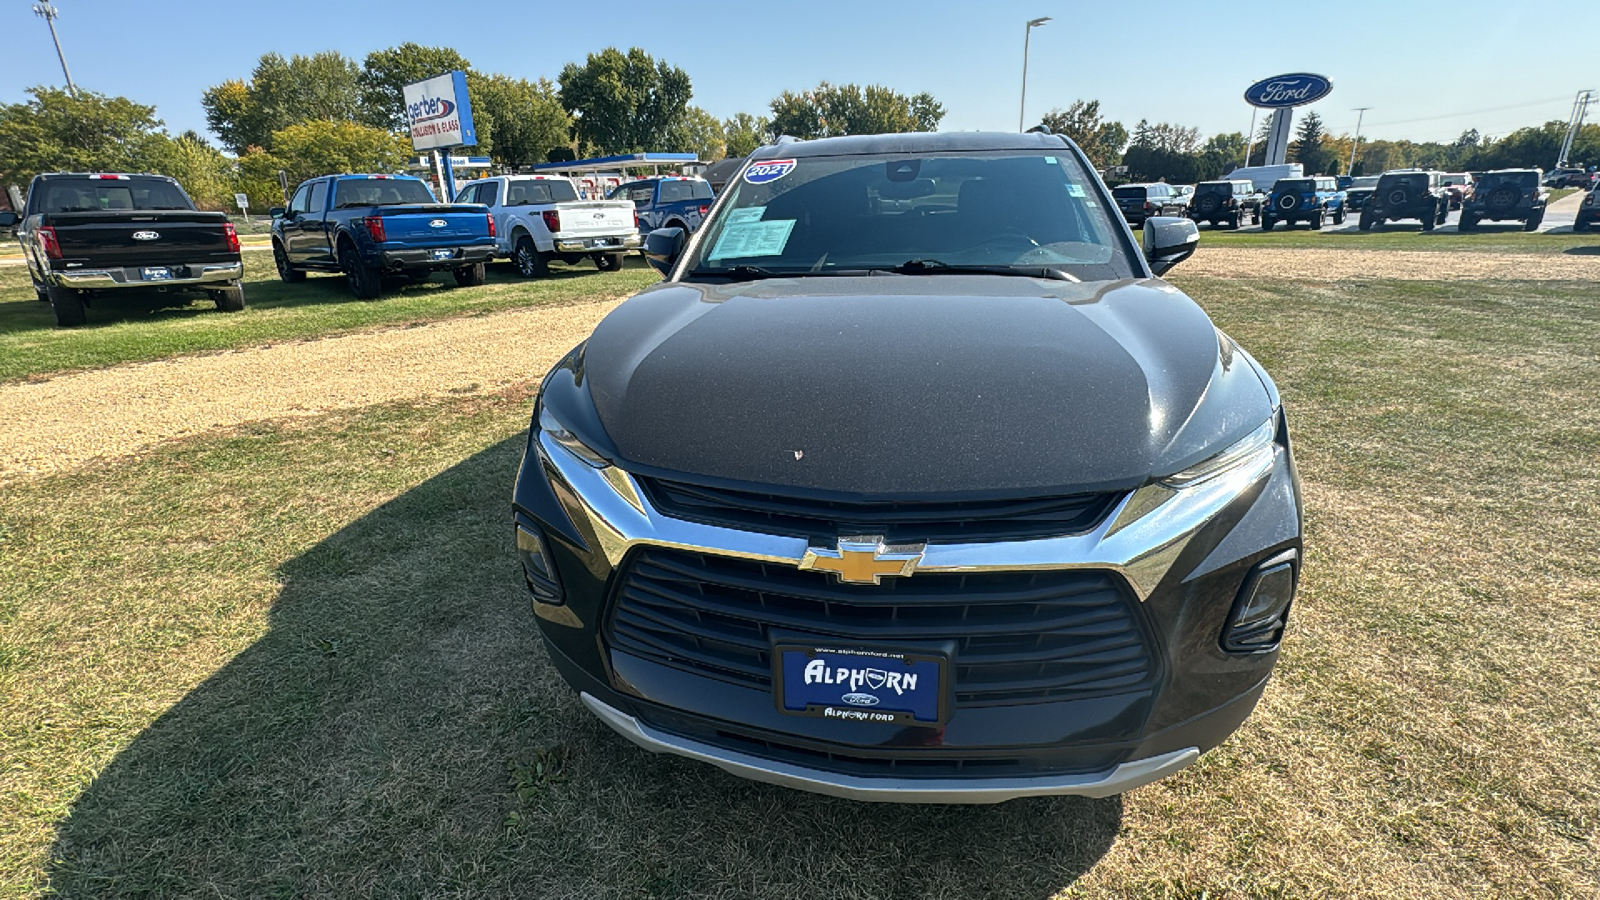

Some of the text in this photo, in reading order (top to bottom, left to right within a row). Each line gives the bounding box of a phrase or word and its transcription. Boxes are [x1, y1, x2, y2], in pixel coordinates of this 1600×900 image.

[1259, 79, 1313, 103] Ford
[408, 95, 441, 125] gerber
[413, 125, 436, 137] COLLISION
[441, 119, 459, 133] GLASS
[747, 164, 790, 177] 2021
[814, 647, 905, 659] www.alphornford.net
[849, 695, 873, 705] Ford
[869, 712, 895, 722] FORD
